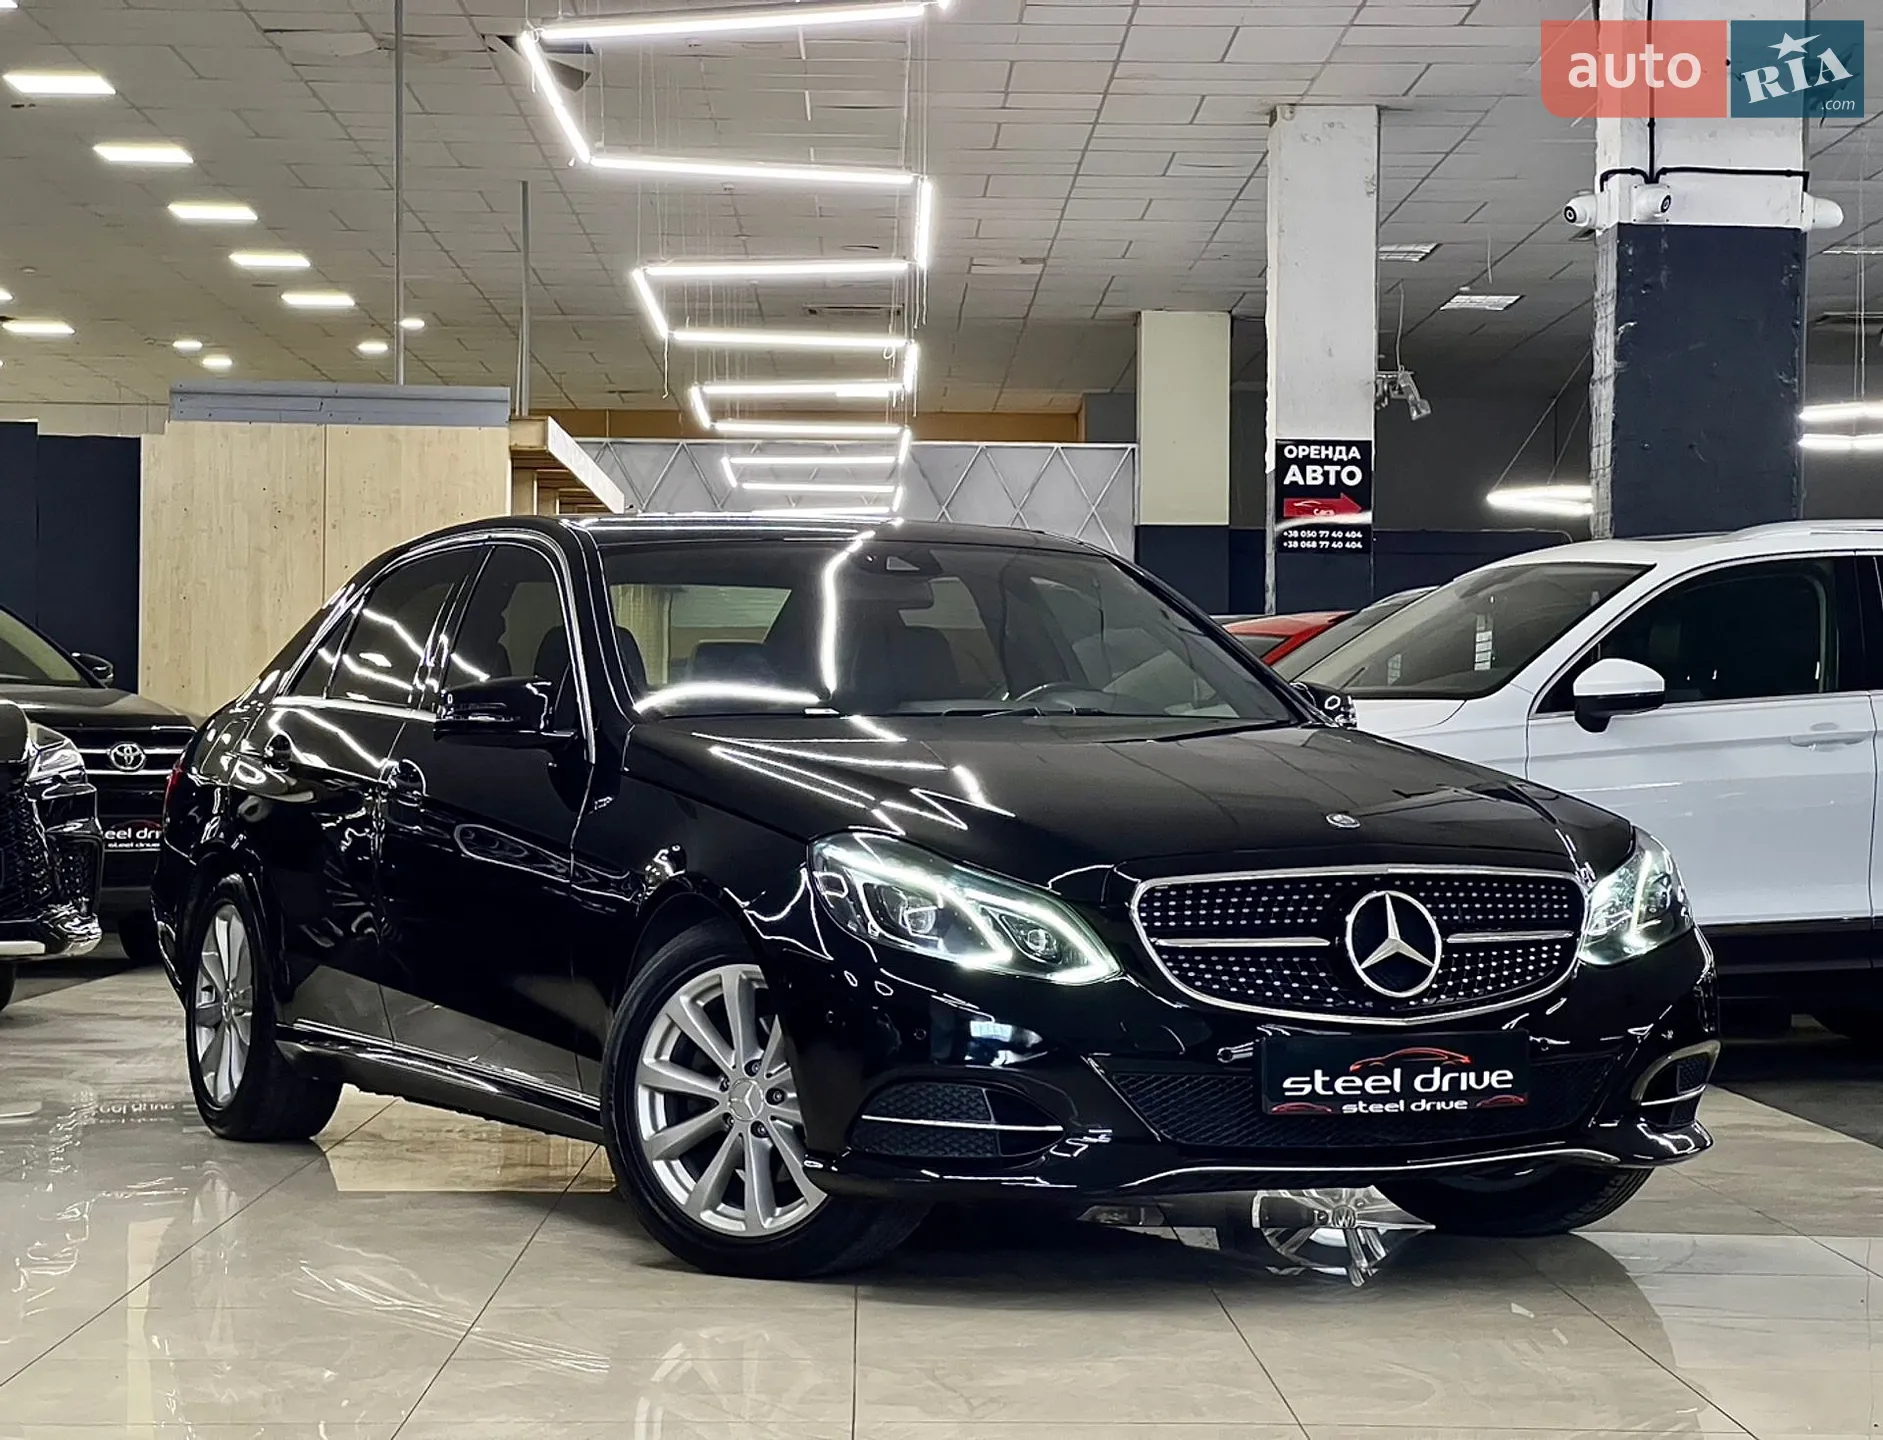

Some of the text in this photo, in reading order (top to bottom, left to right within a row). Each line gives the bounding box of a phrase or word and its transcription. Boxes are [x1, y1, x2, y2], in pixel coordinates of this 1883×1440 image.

[1283, 445, 1361, 461] ОРЕНДА
[1283, 464, 1363, 486] АВТО
[1319, 530, 1330, 538] 77
[1331, 530, 1344, 538] 40
[1345, 530, 1363, 538] 404
[1319, 540, 1330, 549] 77
[1331, 540, 1344, 549] 40
[1345, 540, 1363, 549] 404
[104, 827, 132, 840] eel
[1282, 1066, 1514, 1096] steel drive
[1342, 1098, 1468, 1114] steel drive
